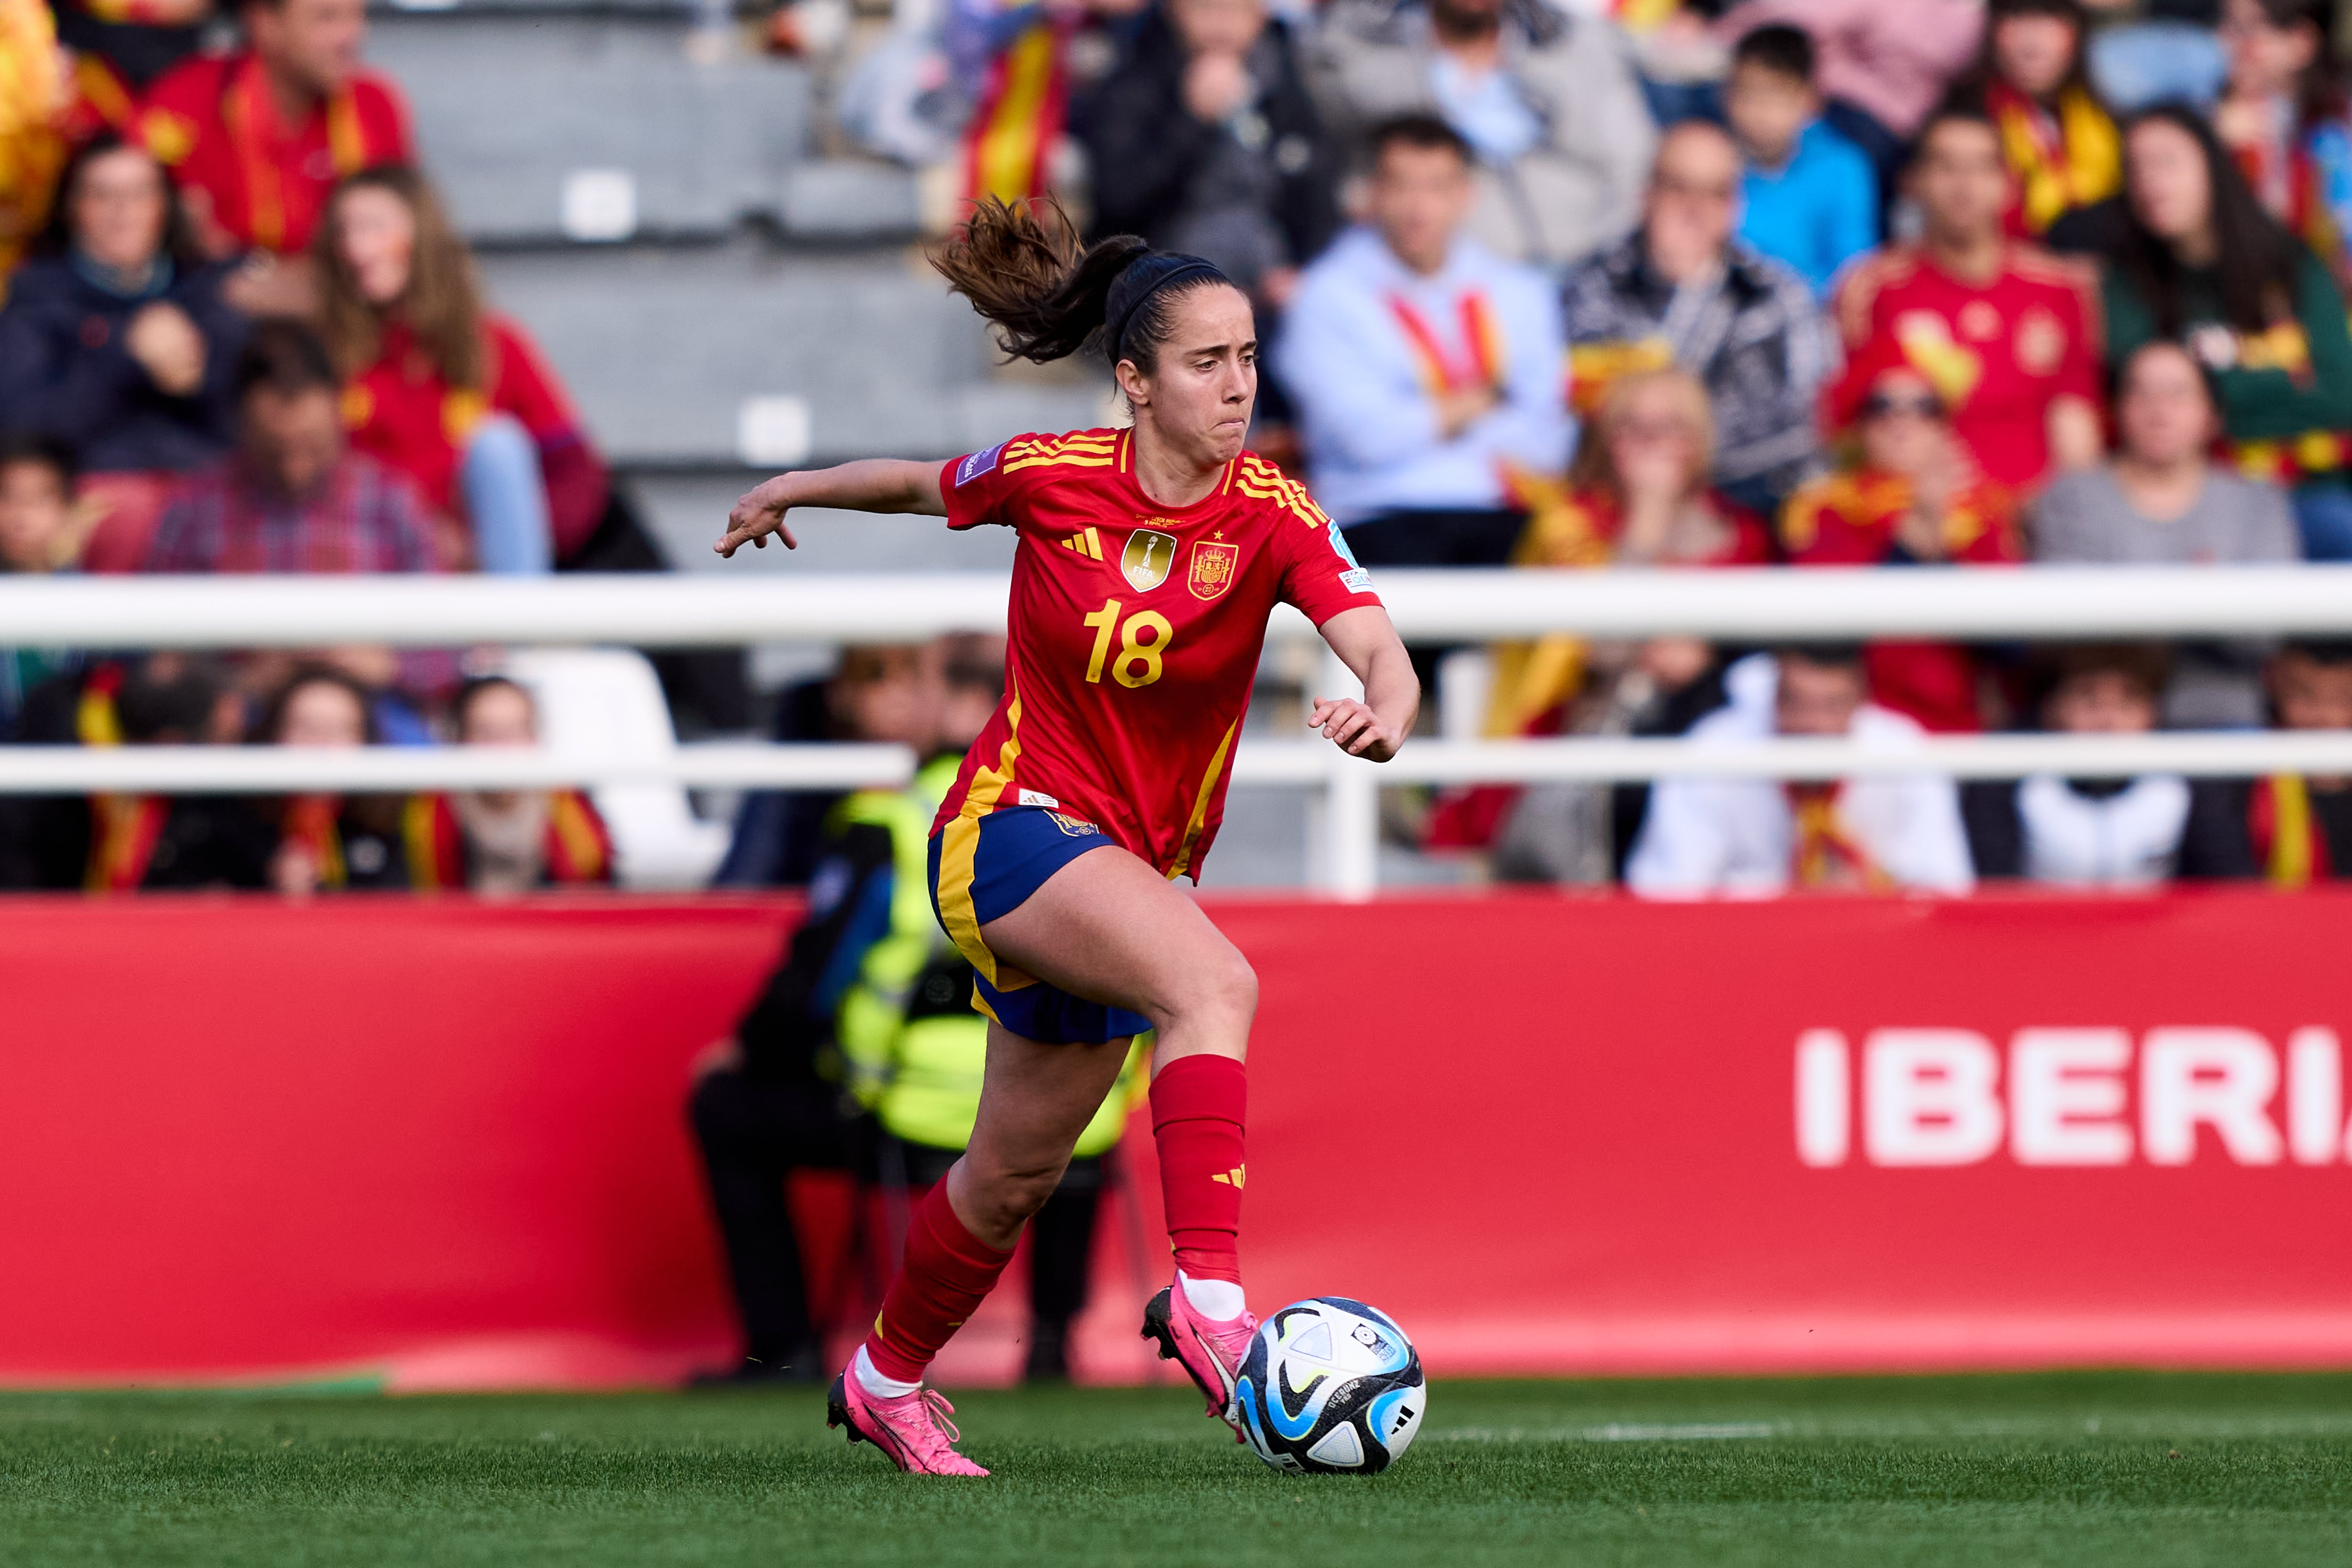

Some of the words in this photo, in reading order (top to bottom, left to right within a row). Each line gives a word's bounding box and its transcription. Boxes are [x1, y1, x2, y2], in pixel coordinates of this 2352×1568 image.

[1132, 565, 1153, 578] FIFA
[1083, 598, 1173, 688] 18
[1793, 1026, 2352, 1167] IBERI
